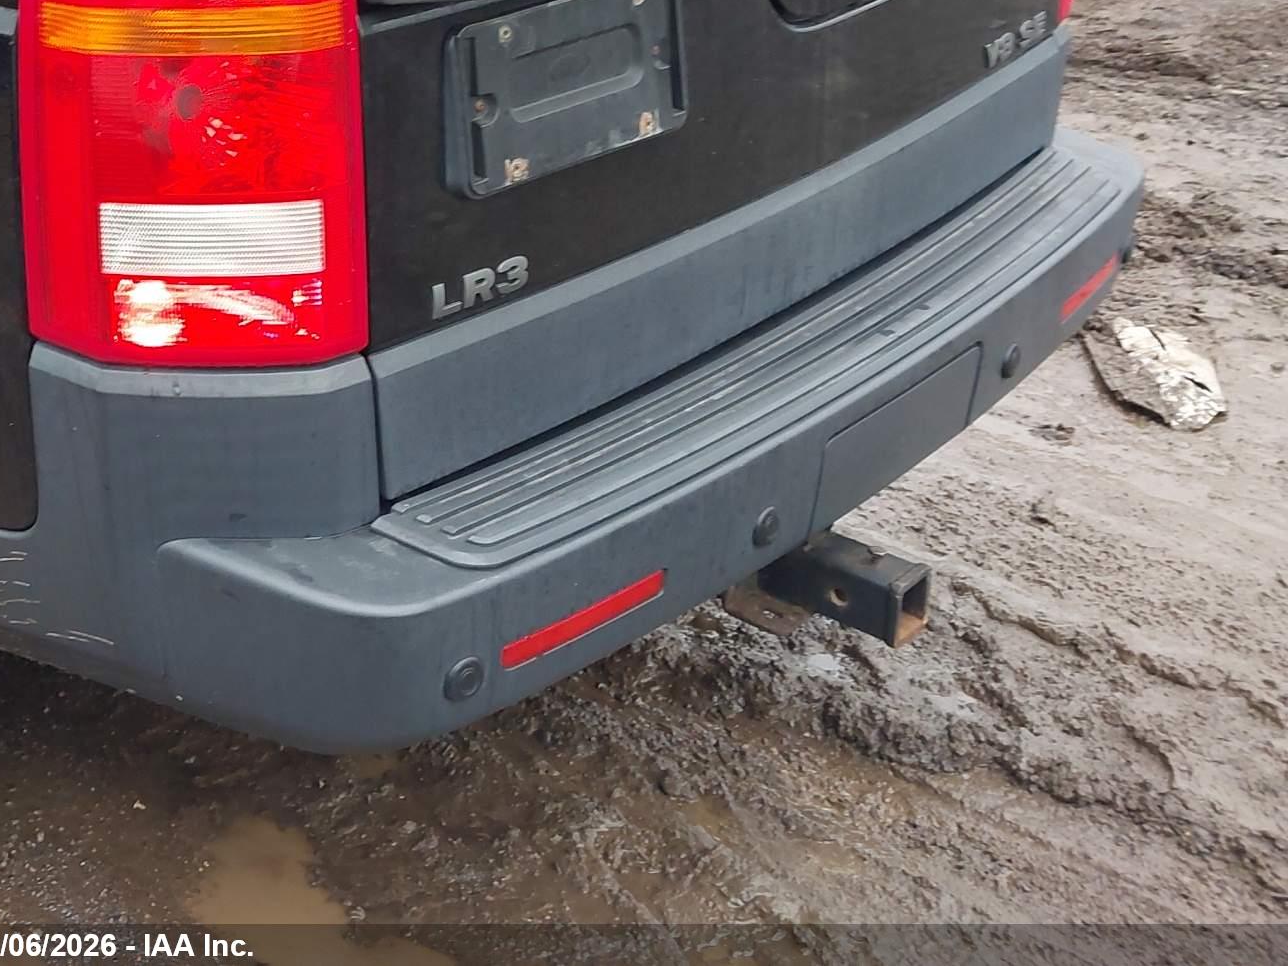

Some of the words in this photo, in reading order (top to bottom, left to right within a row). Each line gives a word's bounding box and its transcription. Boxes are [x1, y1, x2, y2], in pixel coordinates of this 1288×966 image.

[984, 32, 1016, 68] V8
[1018, 10, 1047, 48] SE
[431, 255, 529, 320] LR3
